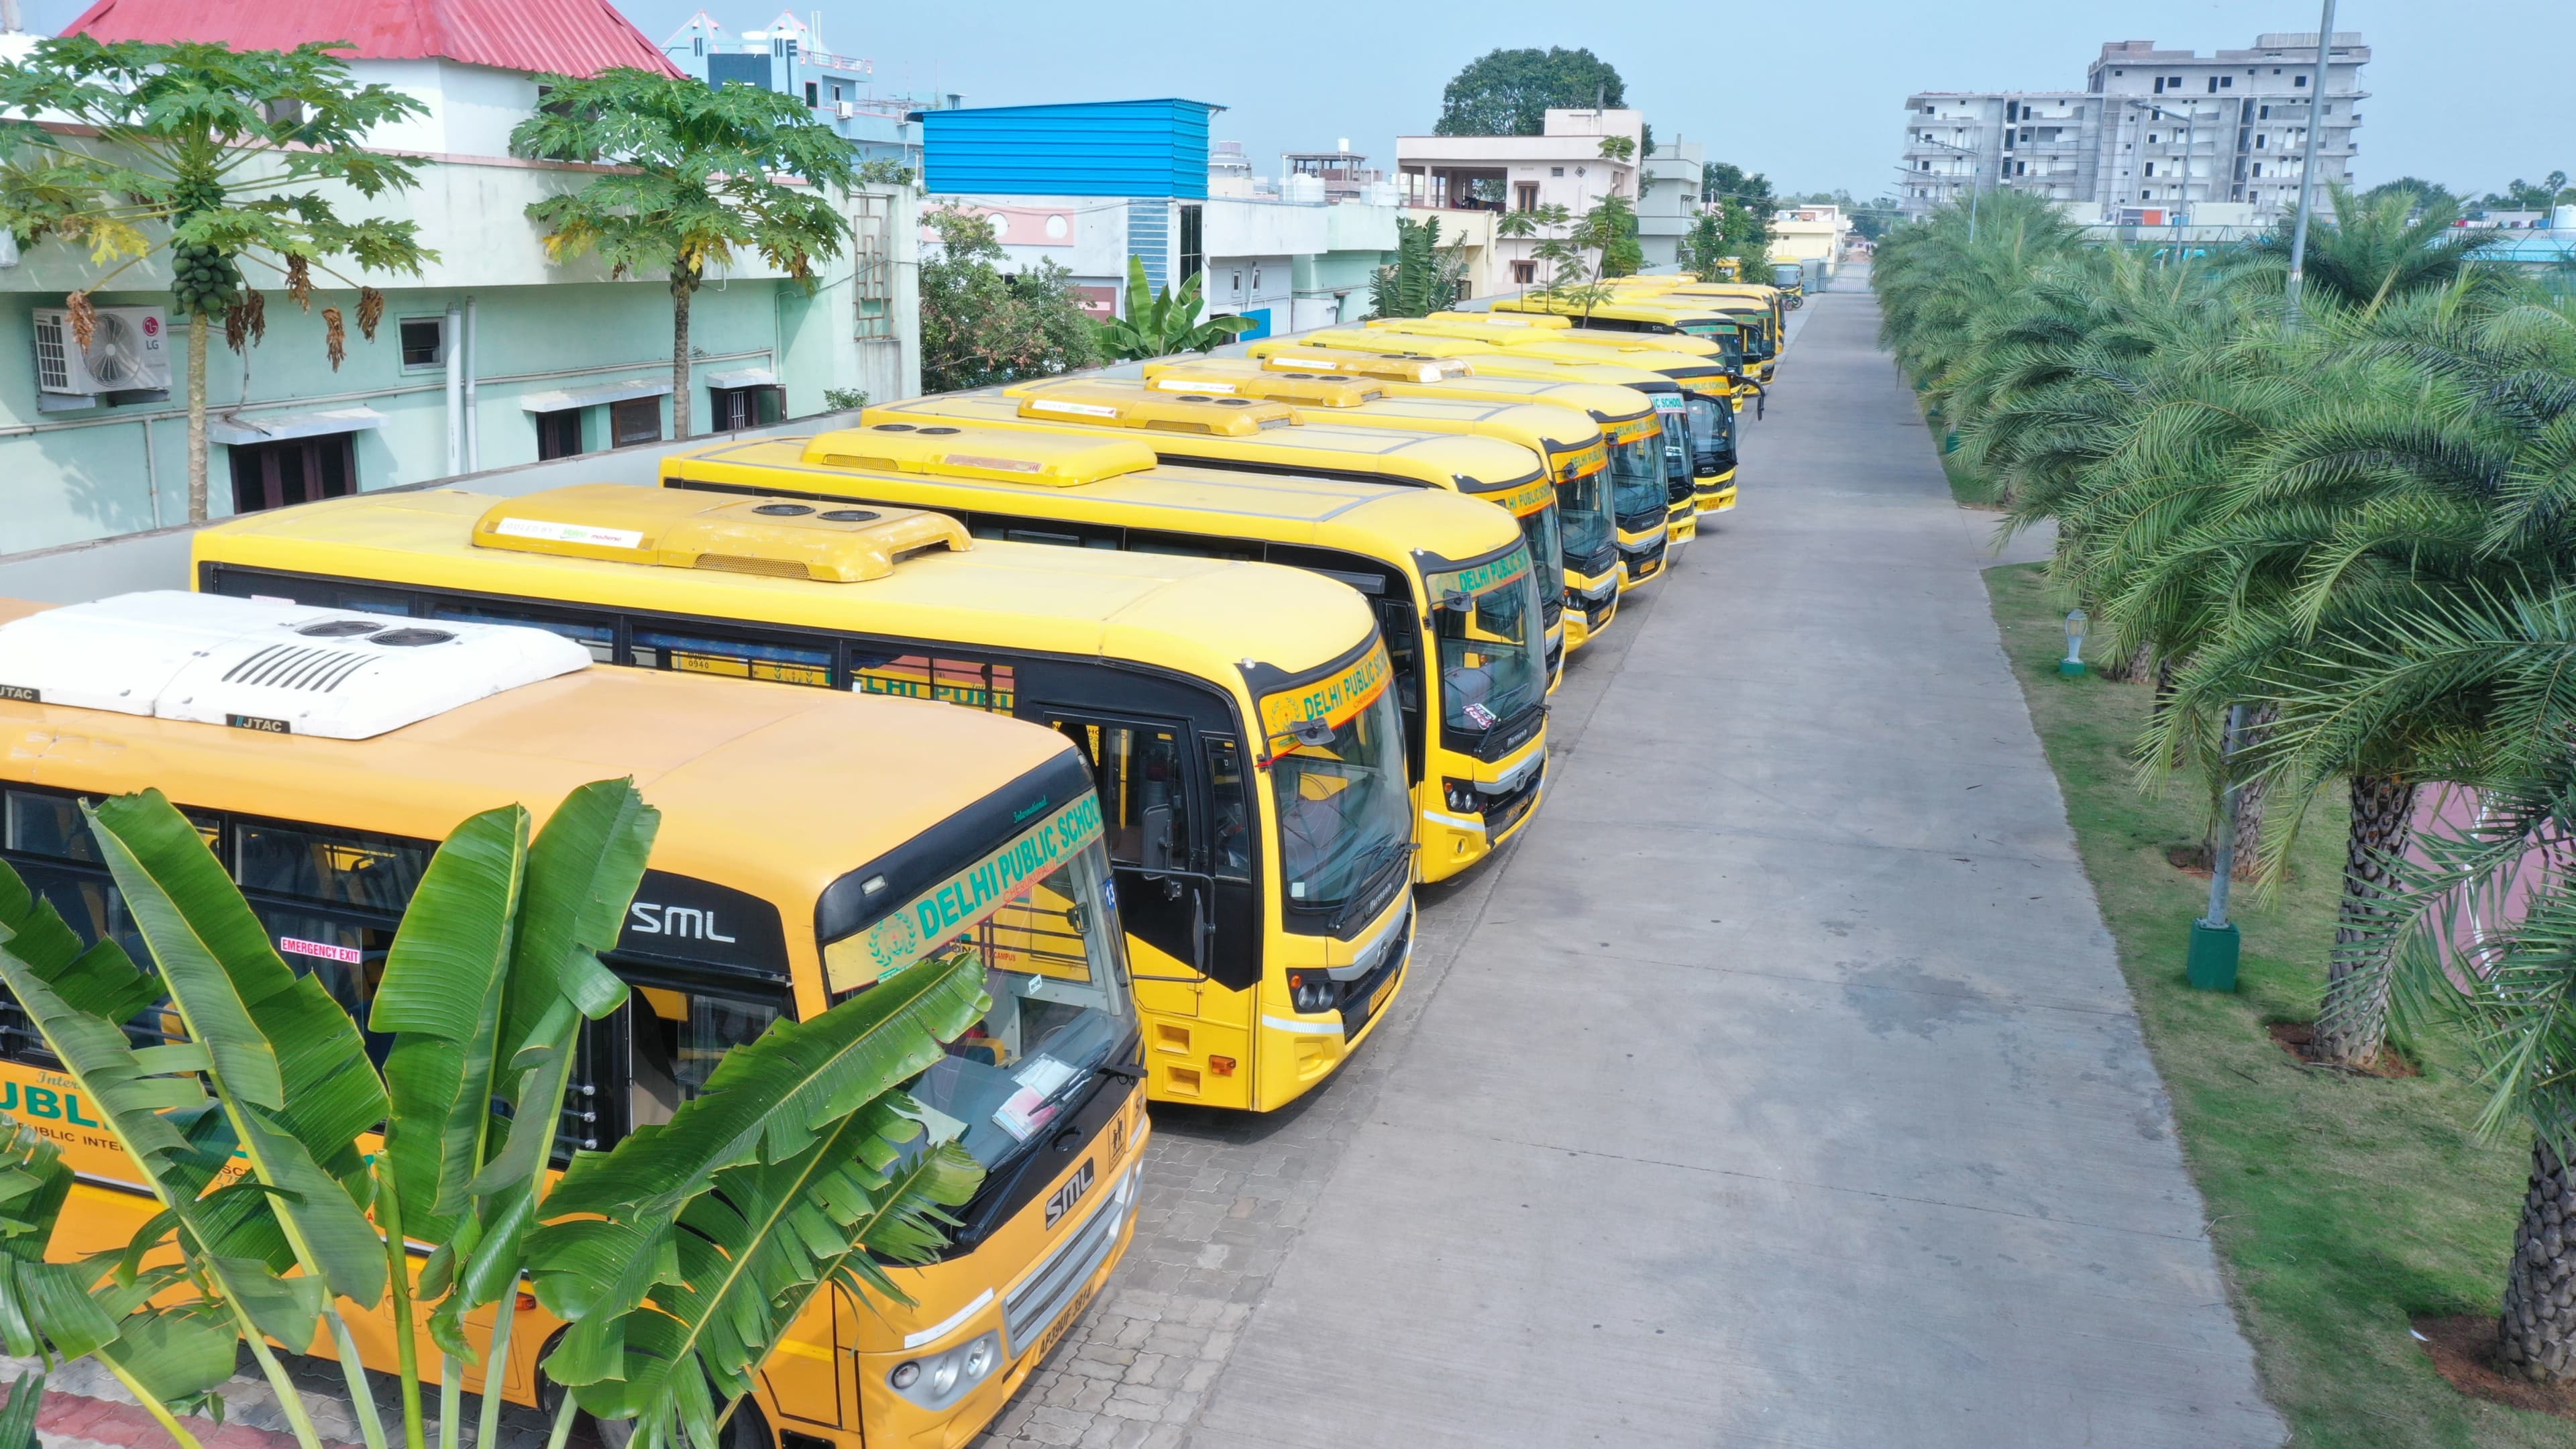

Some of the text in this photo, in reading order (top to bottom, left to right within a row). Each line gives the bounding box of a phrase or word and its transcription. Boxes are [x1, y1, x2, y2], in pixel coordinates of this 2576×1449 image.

[146, 339, 159, 350] LG
[1662, 397, 1683, 408] SCHOOL
[1458, 565, 1490, 592] DELHI
[1489, 555, 1517, 581] PUBLIC
[688, 660, 709, 669] 0940
[1303, 683, 1344, 720] DELHI
[1343, 661, 1376, 702] PUBLIC
[1014, 794, 1049, 824] International
[916, 861, 1000, 940] DELHI
[998, 825, 1058, 889] PUBLIC
[631, 902, 736, 943] SML
[282, 938, 359, 962] EMERGENCY EXIT
[1045, 1165, 1094, 1229] SML
